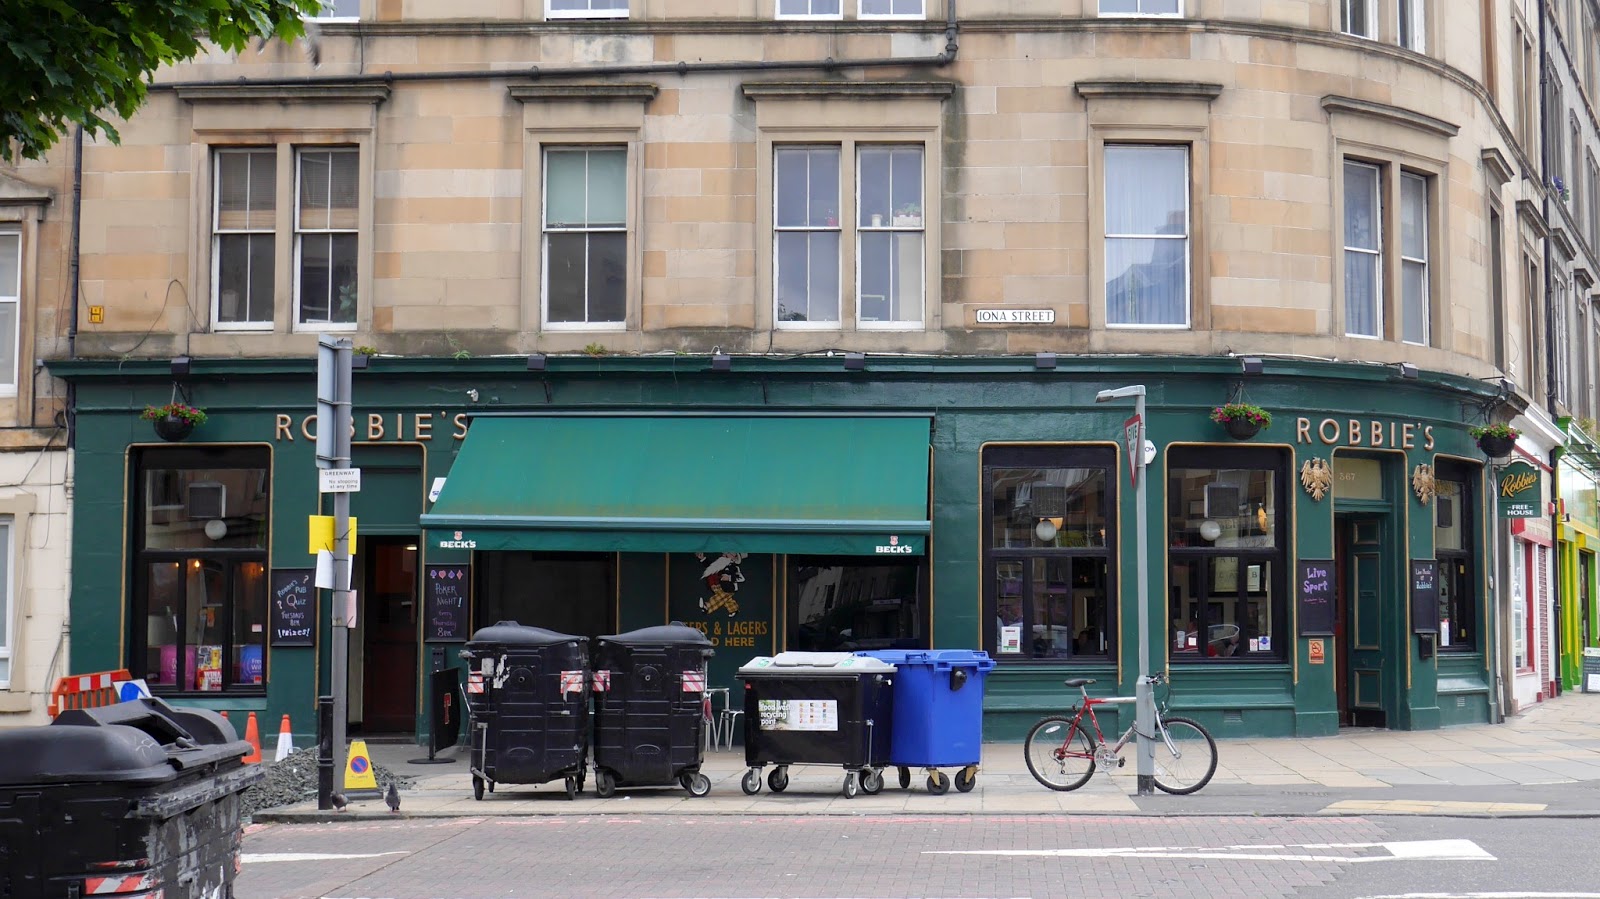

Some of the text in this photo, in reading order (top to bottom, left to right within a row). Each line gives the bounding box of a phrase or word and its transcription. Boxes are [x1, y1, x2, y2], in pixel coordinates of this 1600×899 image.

[979, 311, 1052, 321] IONA STREET
[275, 411, 467, 442] ROBIE'S
[1296, 417, 1435, 451] ROBBIE'S
[440, 540, 477, 549] BECK'S
[875, 544, 913, 554] BECK'S
[1306, 567, 1327, 579] Live
[295, 586, 307, 594] PUB
[435, 582, 458, 596] POKER
[1303, 580, 1329, 595] Sport
[713, 621, 721, 635] &
[727, 621, 768, 635] LAGERS
[724, 637, 755, 646] HERE
[760, 711, 787, 720] recycling
[760, 718, 776, 726] point
